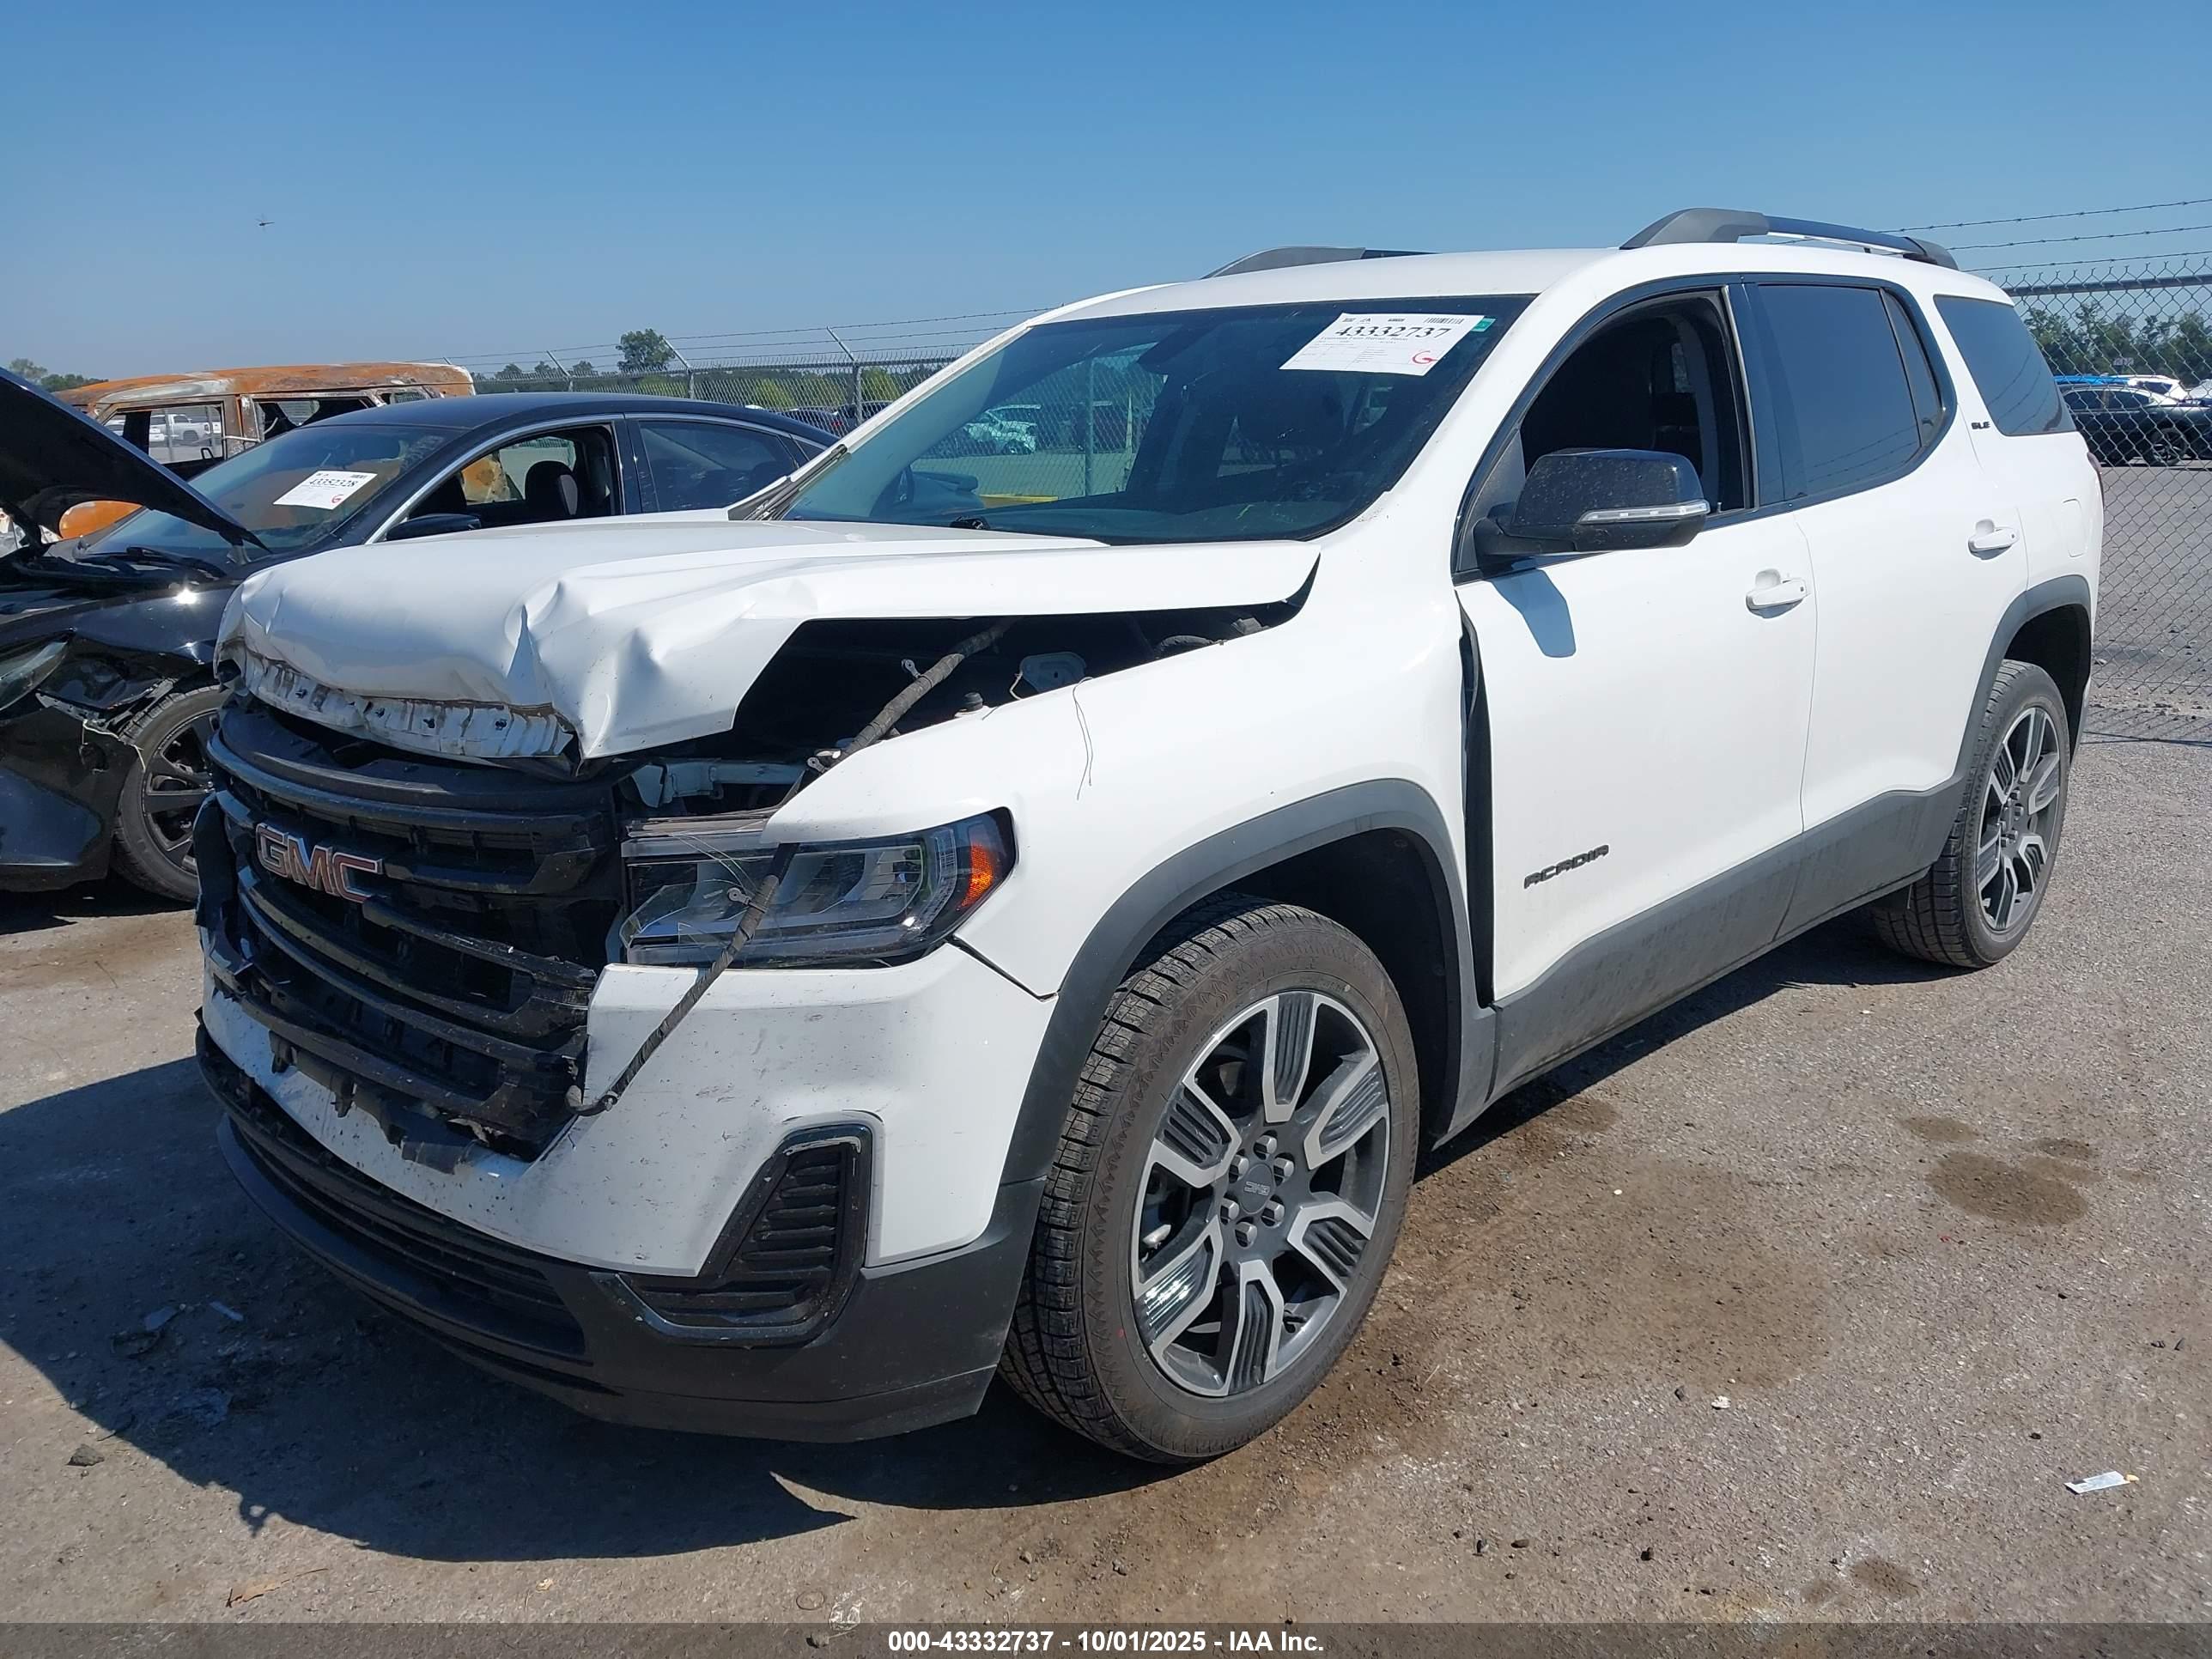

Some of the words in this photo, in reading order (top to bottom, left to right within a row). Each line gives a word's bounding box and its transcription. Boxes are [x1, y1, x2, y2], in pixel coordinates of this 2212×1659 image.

[1335, 325, 1452, 338] 43332737
[1971, 421, 1991, 430] SLE
[256, 823, 384, 903] GMC
[1523, 844, 1609, 890] ACADIA
